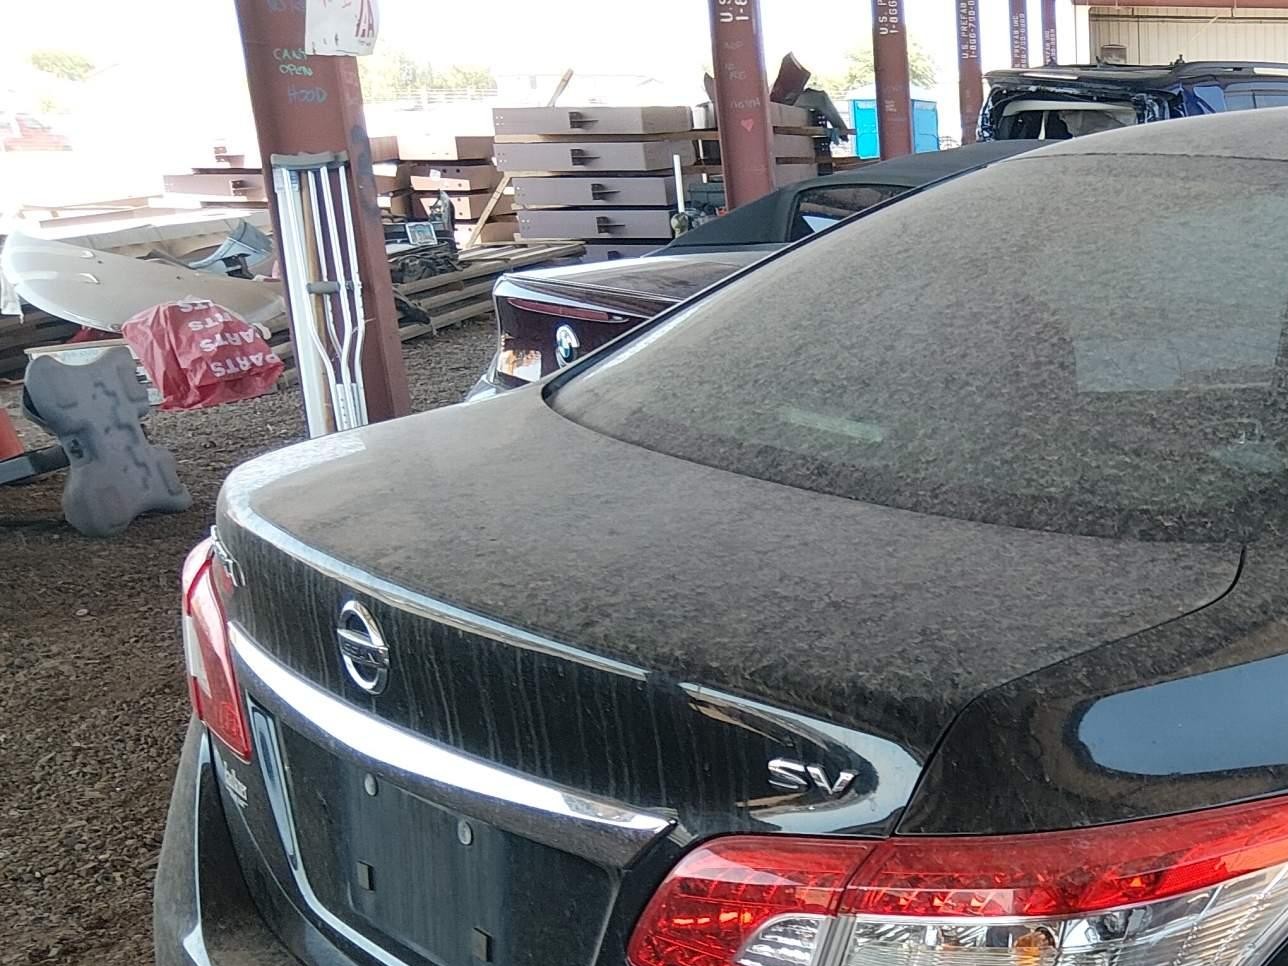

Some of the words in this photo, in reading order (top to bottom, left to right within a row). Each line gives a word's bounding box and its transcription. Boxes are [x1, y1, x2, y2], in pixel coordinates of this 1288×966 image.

[200, 328, 261, 352] ARTS
[210, 352, 280, 378] PARTS
[767, 759, 857, 795] SV
